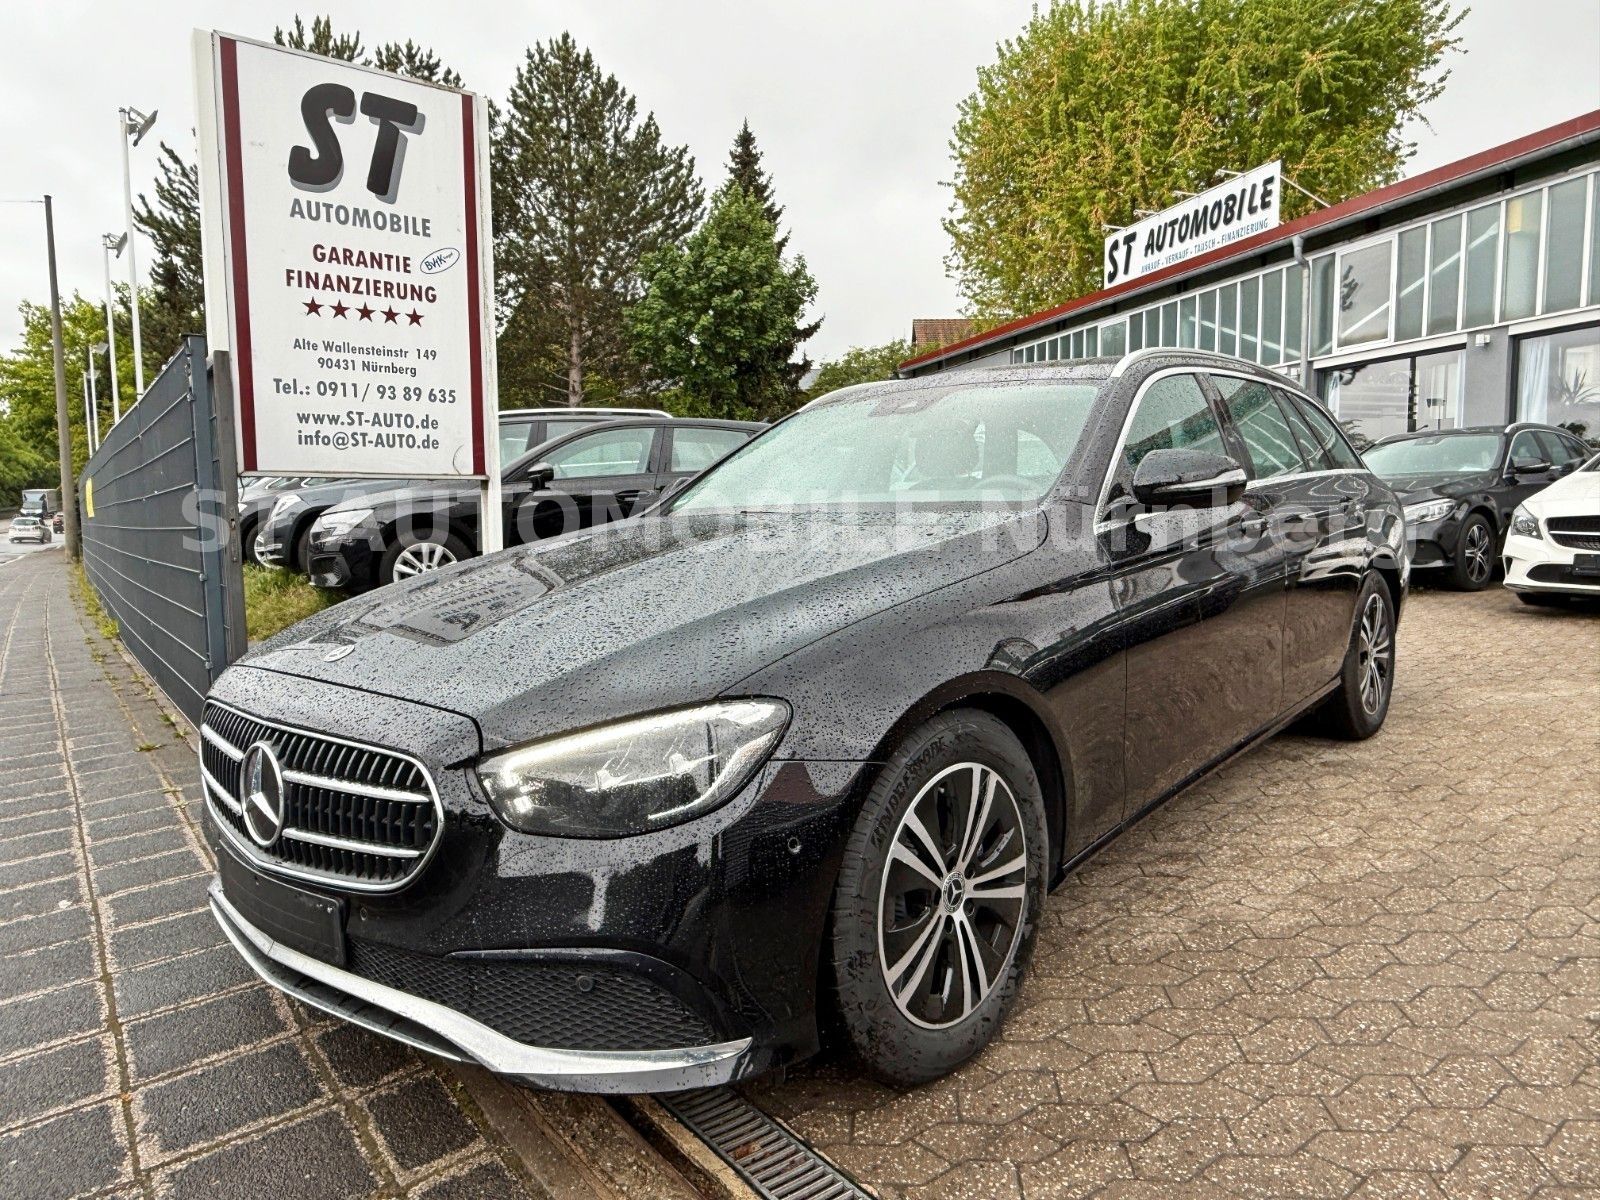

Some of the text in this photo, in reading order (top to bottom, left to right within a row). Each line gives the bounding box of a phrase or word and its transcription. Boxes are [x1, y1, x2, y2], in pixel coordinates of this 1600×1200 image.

[288, 83, 425, 204] ST
[290, 198, 431, 237] AUTOMOBILE
[1107, 176, 1274, 283] ST AUTOMOBILE
[1194, 238, 1216, 255] TAUSCH
[1221, 217, 1269, 245] FINANZIERUNG
[313, 244, 411, 273] GARANTIE
[286, 269, 437, 303] FINANZIERUNG
[293, 338, 437, 361] Alte Wallensteinstr 149
[317, 357, 417, 378] 90431 Nürnberg
[273, 378, 310, 397] Tel.:
[377, 384, 396, 401] 93
[403, 386, 422, 403] 89
[428, 388, 456, 404] 635
[297, 411, 439, 430] www.ST-AUTO.de
[297, 429, 440, 451] info@ST-AUTO.de
